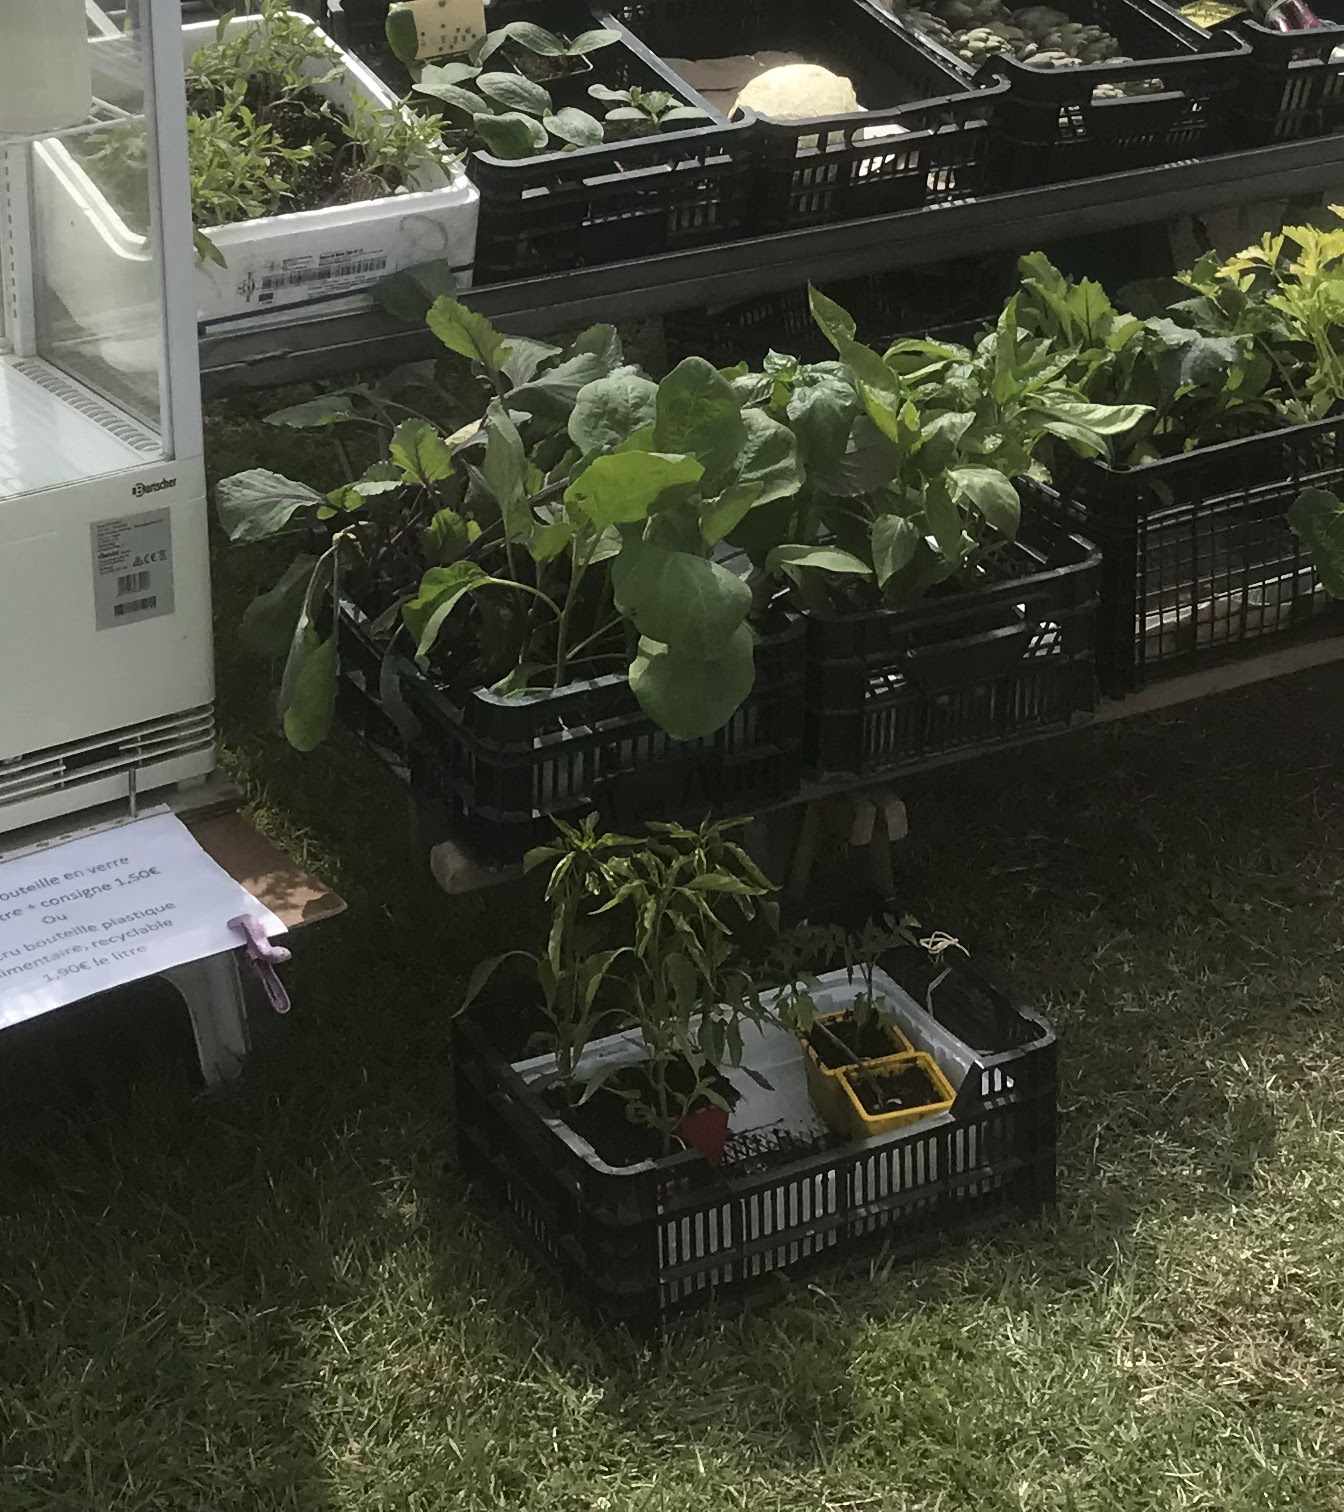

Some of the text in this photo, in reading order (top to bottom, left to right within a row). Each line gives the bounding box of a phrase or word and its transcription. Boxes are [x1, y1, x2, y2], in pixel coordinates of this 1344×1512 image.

[63, 869, 85, 881] en
[86, 856, 130, 875] verre
[40, 883, 113, 908] consigne
[115, 866, 162, 887] 1,50€
[23, 923, 99, 952] bouteille
[101, 901, 176, 930] plastique
[41, 912, 68, 925] Ou
[91, 918, 174, 948] recyclable
[92, 956, 111, 967] le
[112, 944, 148, 962] litre
